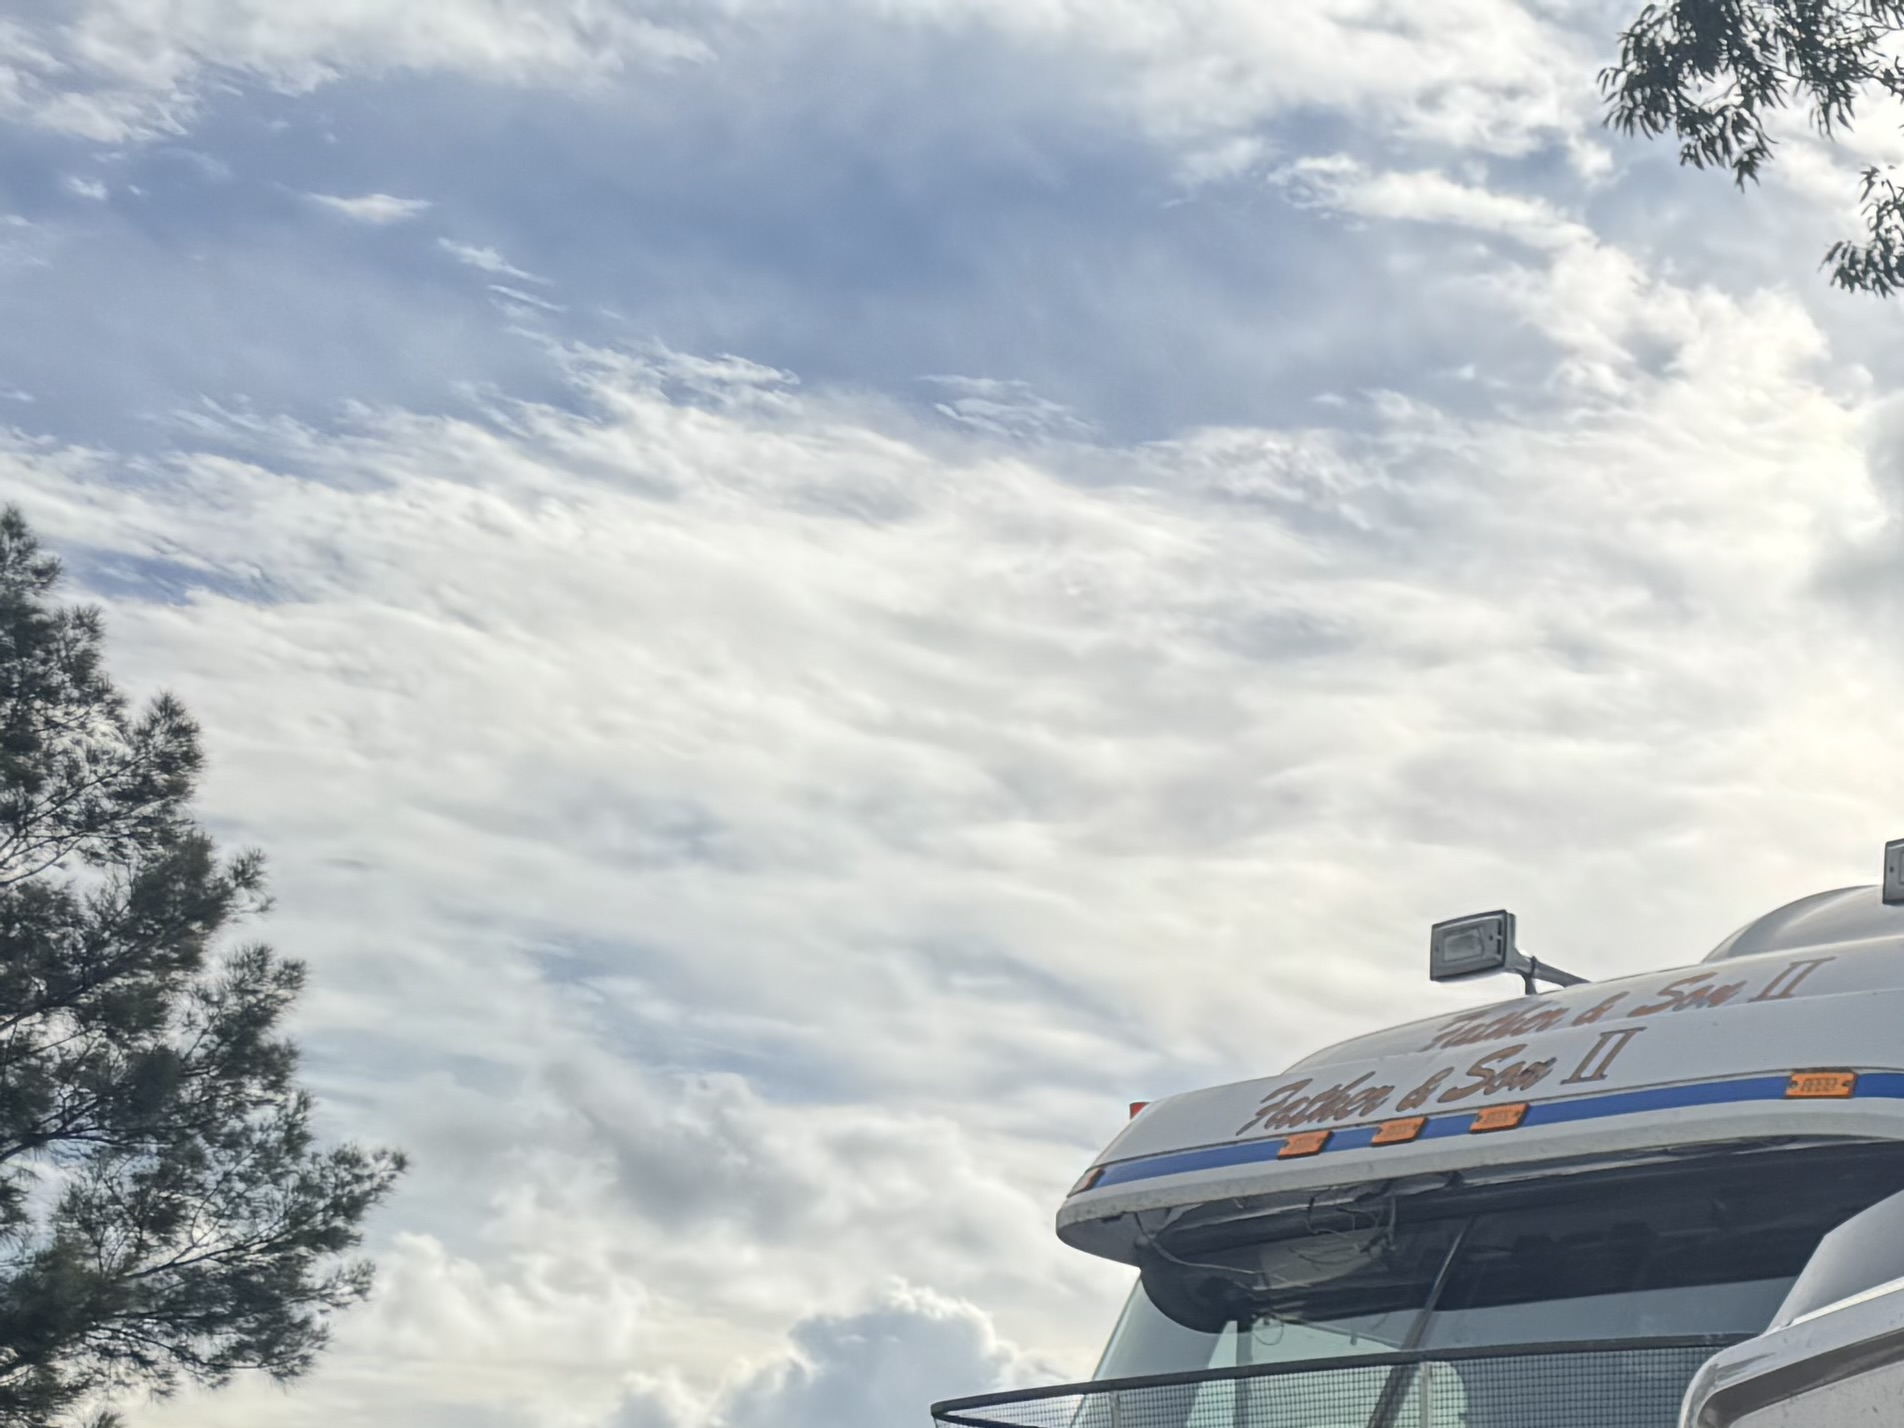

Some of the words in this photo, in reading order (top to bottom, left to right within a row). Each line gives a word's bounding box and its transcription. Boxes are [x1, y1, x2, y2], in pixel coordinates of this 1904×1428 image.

[1629, 971, 1747, 1018] Son
[1236, 1070, 1396, 1136] Father
[1396, 1066, 1455, 1113] &
[1437, 1043, 1558, 1104] Son
[1560, 1026, 1648, 1085] II
